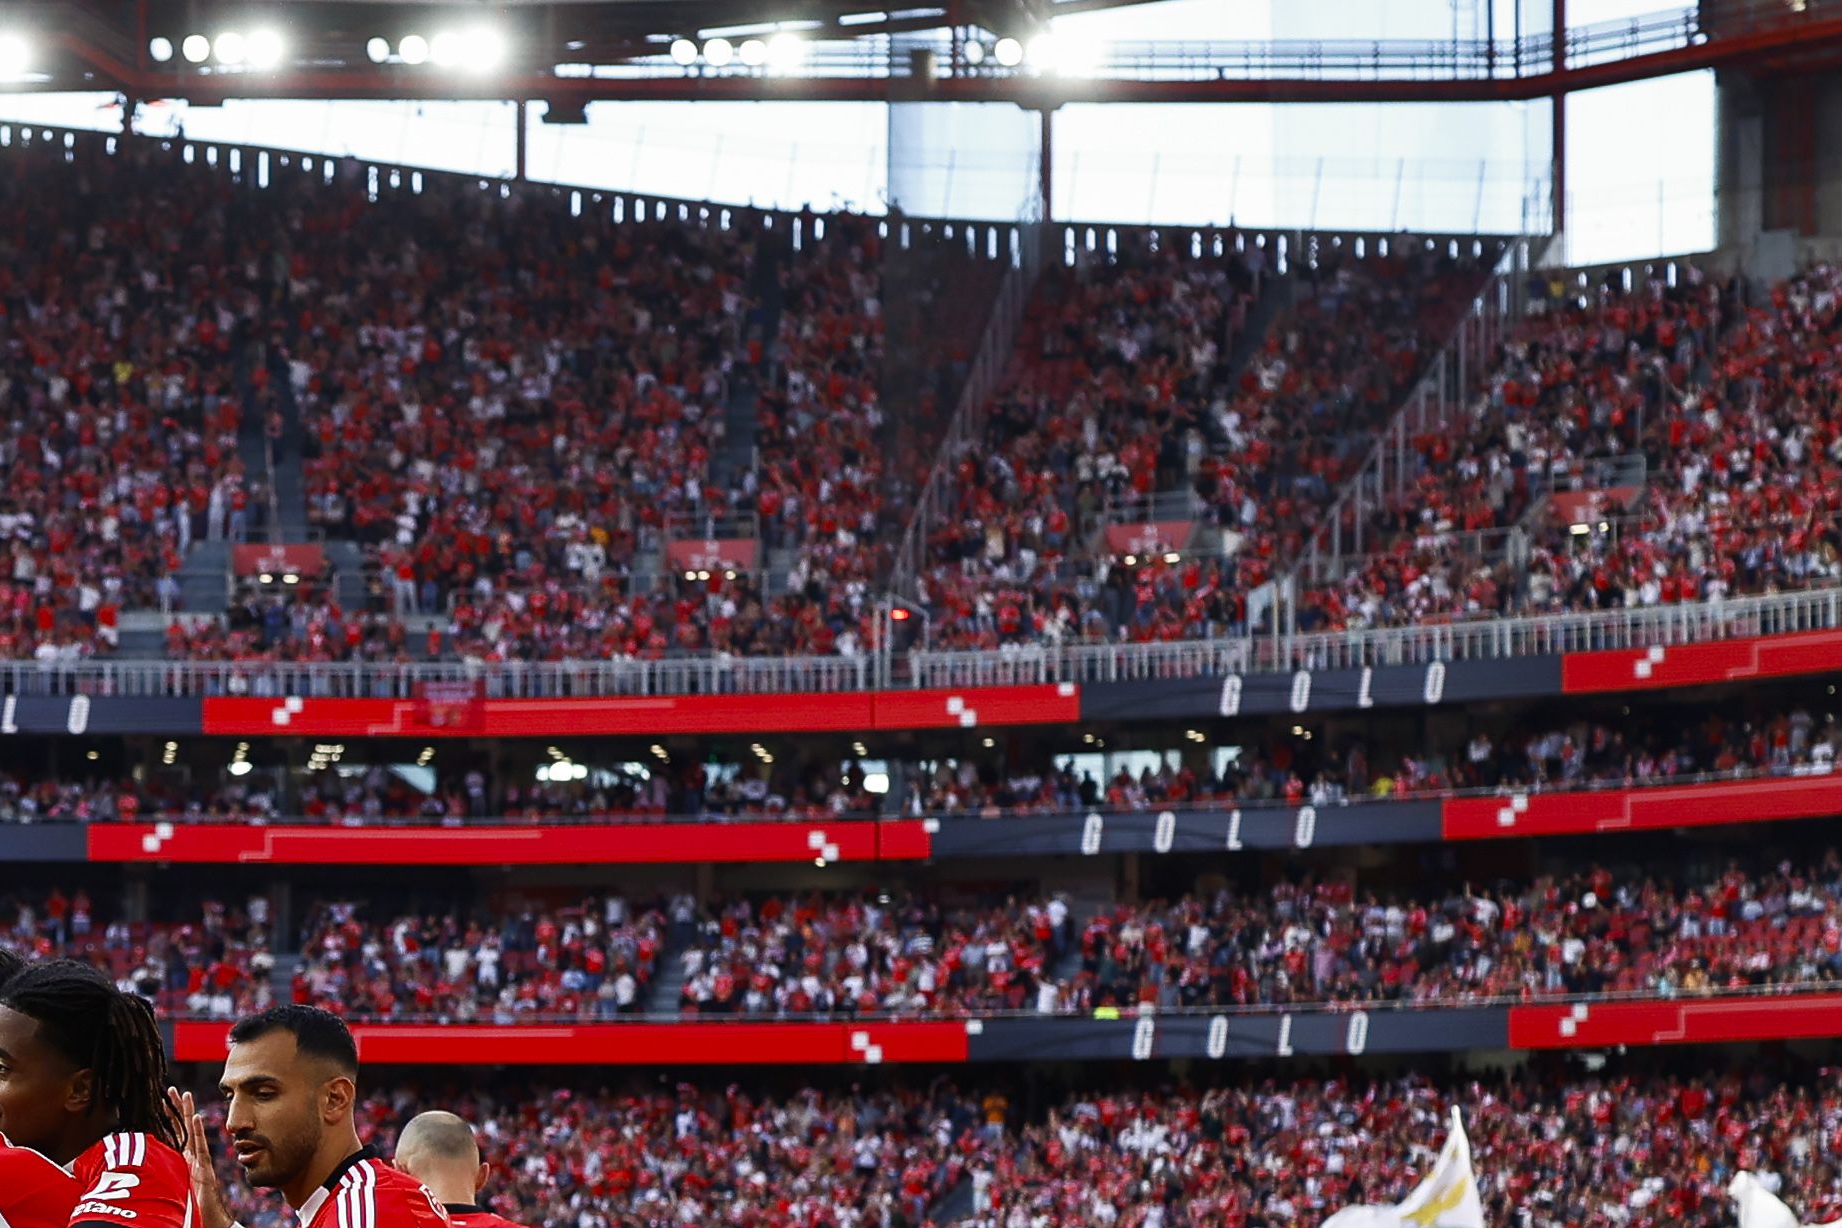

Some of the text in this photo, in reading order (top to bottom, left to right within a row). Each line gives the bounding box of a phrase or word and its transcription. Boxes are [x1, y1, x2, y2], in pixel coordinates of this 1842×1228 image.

[1220, 660, 1446, 717] GOLO
[1081, 805, 1316, 855] GOLO
[1132, 1010, 1368, 1061] GOLO
